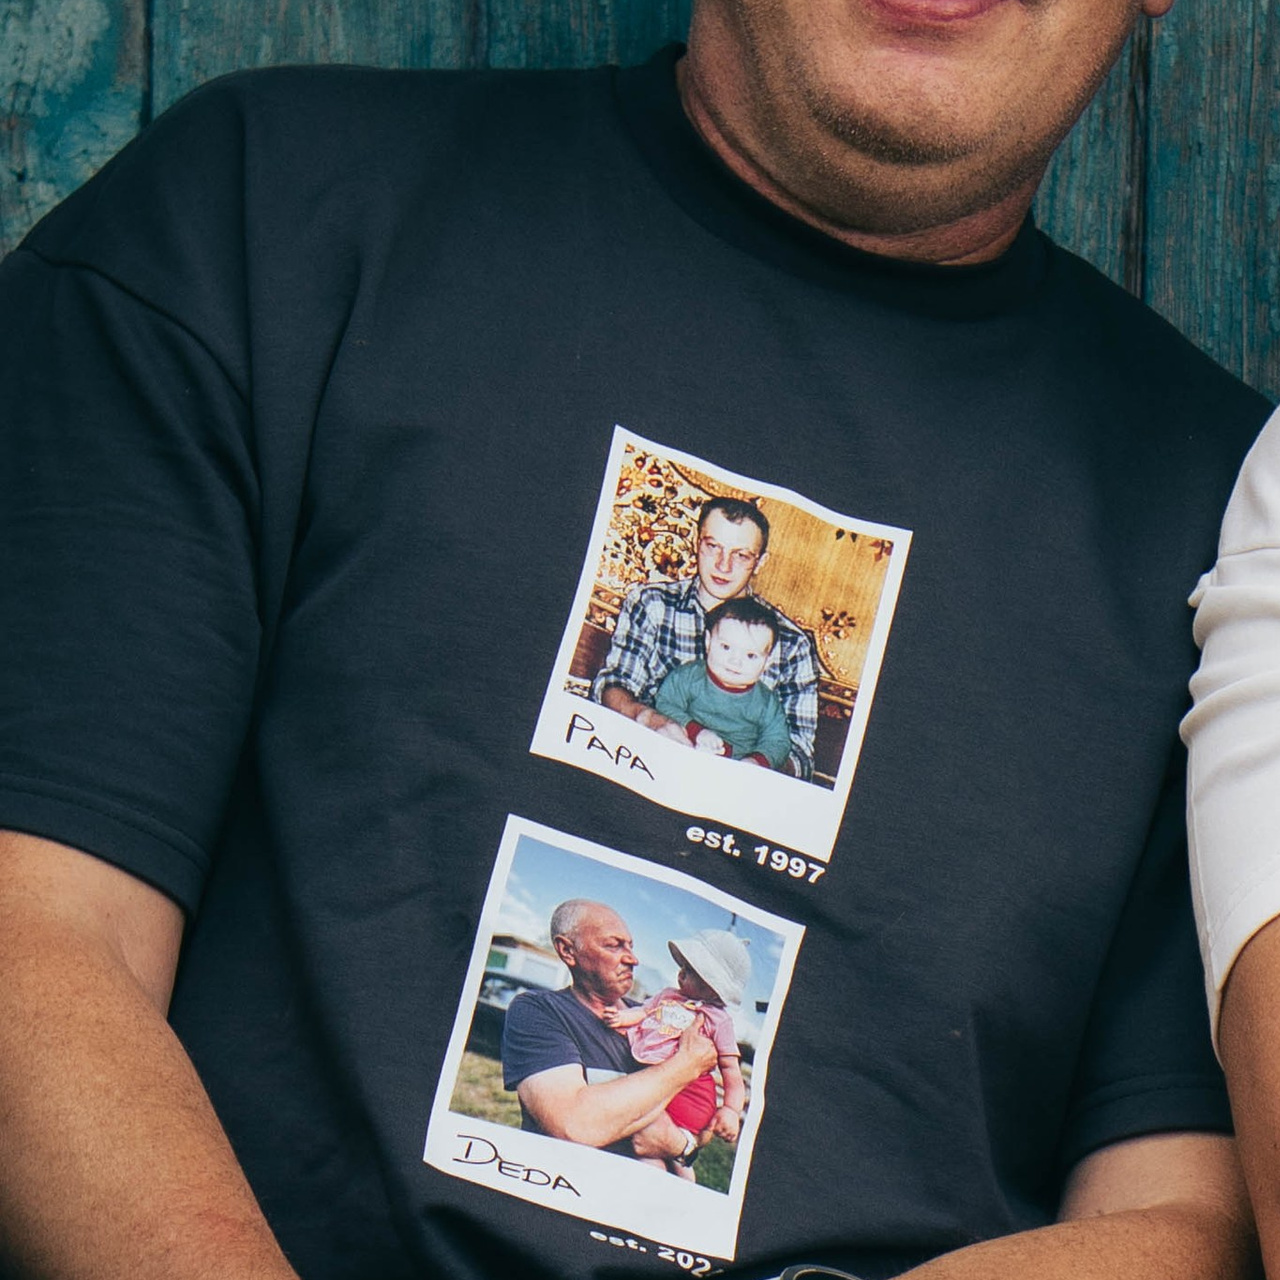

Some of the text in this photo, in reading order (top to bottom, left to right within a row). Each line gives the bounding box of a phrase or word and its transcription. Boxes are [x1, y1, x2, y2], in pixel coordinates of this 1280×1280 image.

[565, 713, 655, 780] PAPA
[685, 825, 826, 884] est. 1997
[452, 1133, 581, 1197] DEDA
